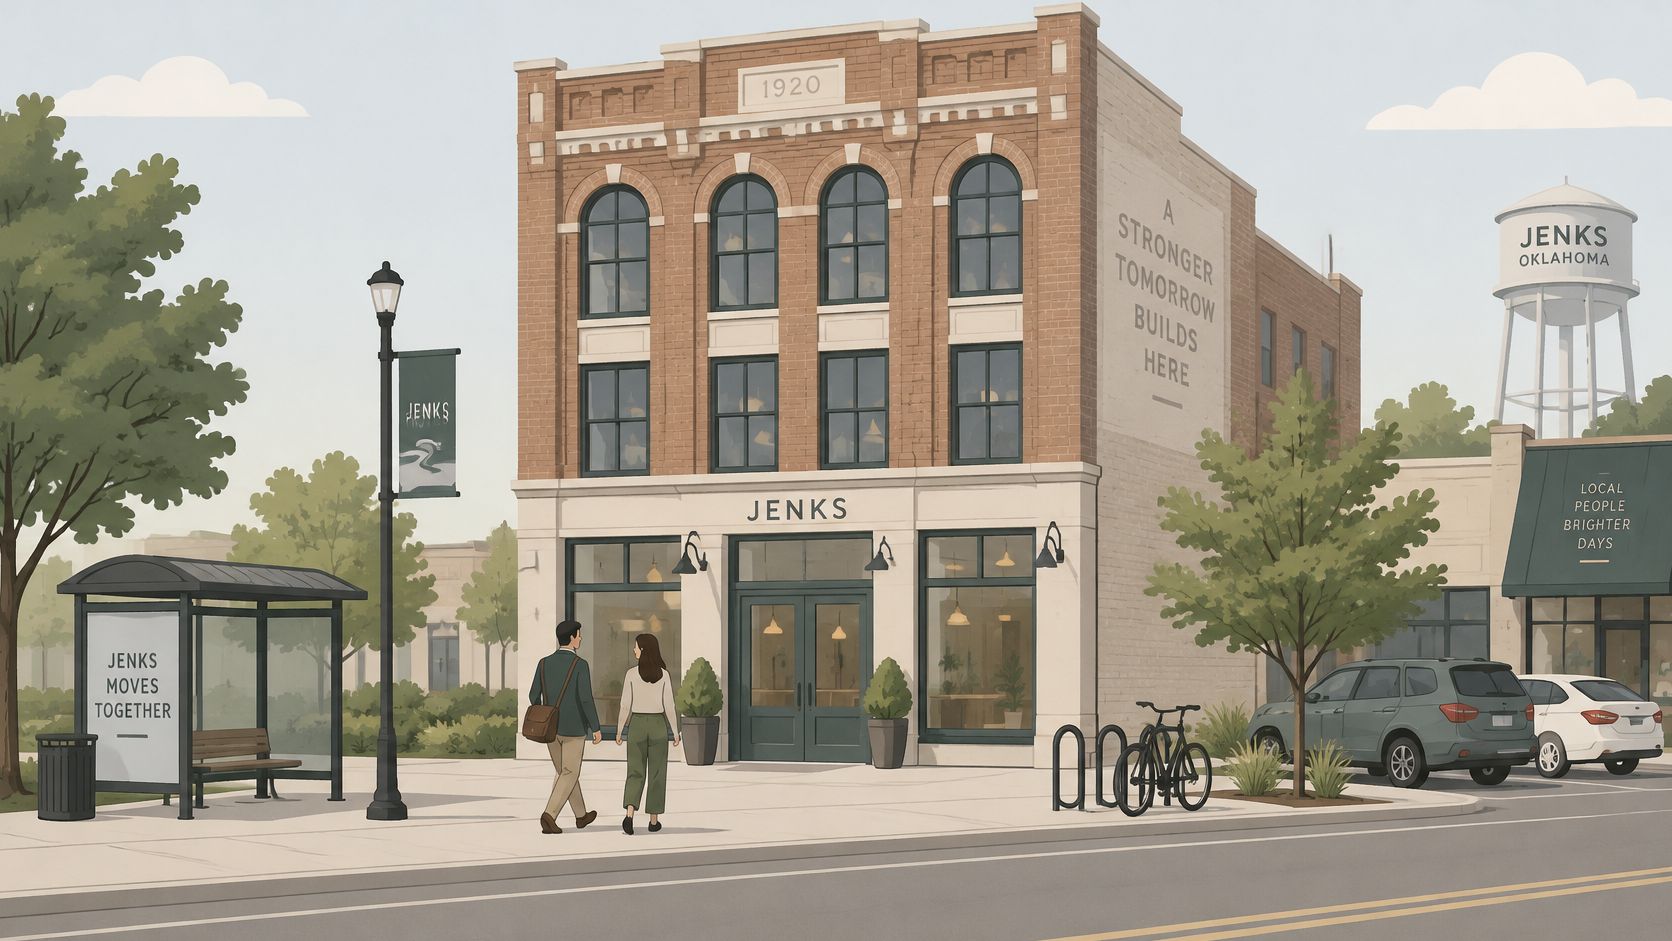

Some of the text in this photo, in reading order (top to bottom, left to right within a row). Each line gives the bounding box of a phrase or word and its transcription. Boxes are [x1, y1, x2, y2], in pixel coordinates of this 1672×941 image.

[762, 75, 820, 98] 1920
[1162, 198, 1175, 226] A
[1520, 224, 1608, 248] JENKS
[1118, 212, 1213, 285] STRONGER
[1519, 251, 1610, 267] OKLAHOMA
[1115, 252, 1215, 323] TOMORROW
[1134, 303, 1198, 352] BUILDS
[1144, 347, 1190, 387] HERE
[406, 401, 449, 423] JENKS
[1581, 482, 1623, 494] LOCAL
[746, 497, 848, 522] JENKS
[1574, 500, 1625, 512] PEOPLE
[1563, 518, 1631, 531] BRIGHTER
[1577, 537, 1613, 549] DAYS
[107, 652, 158, 669] JENKS
[106, 677, 159, 694] MOVES
[94, 702, 172, 719] TOGETHER
